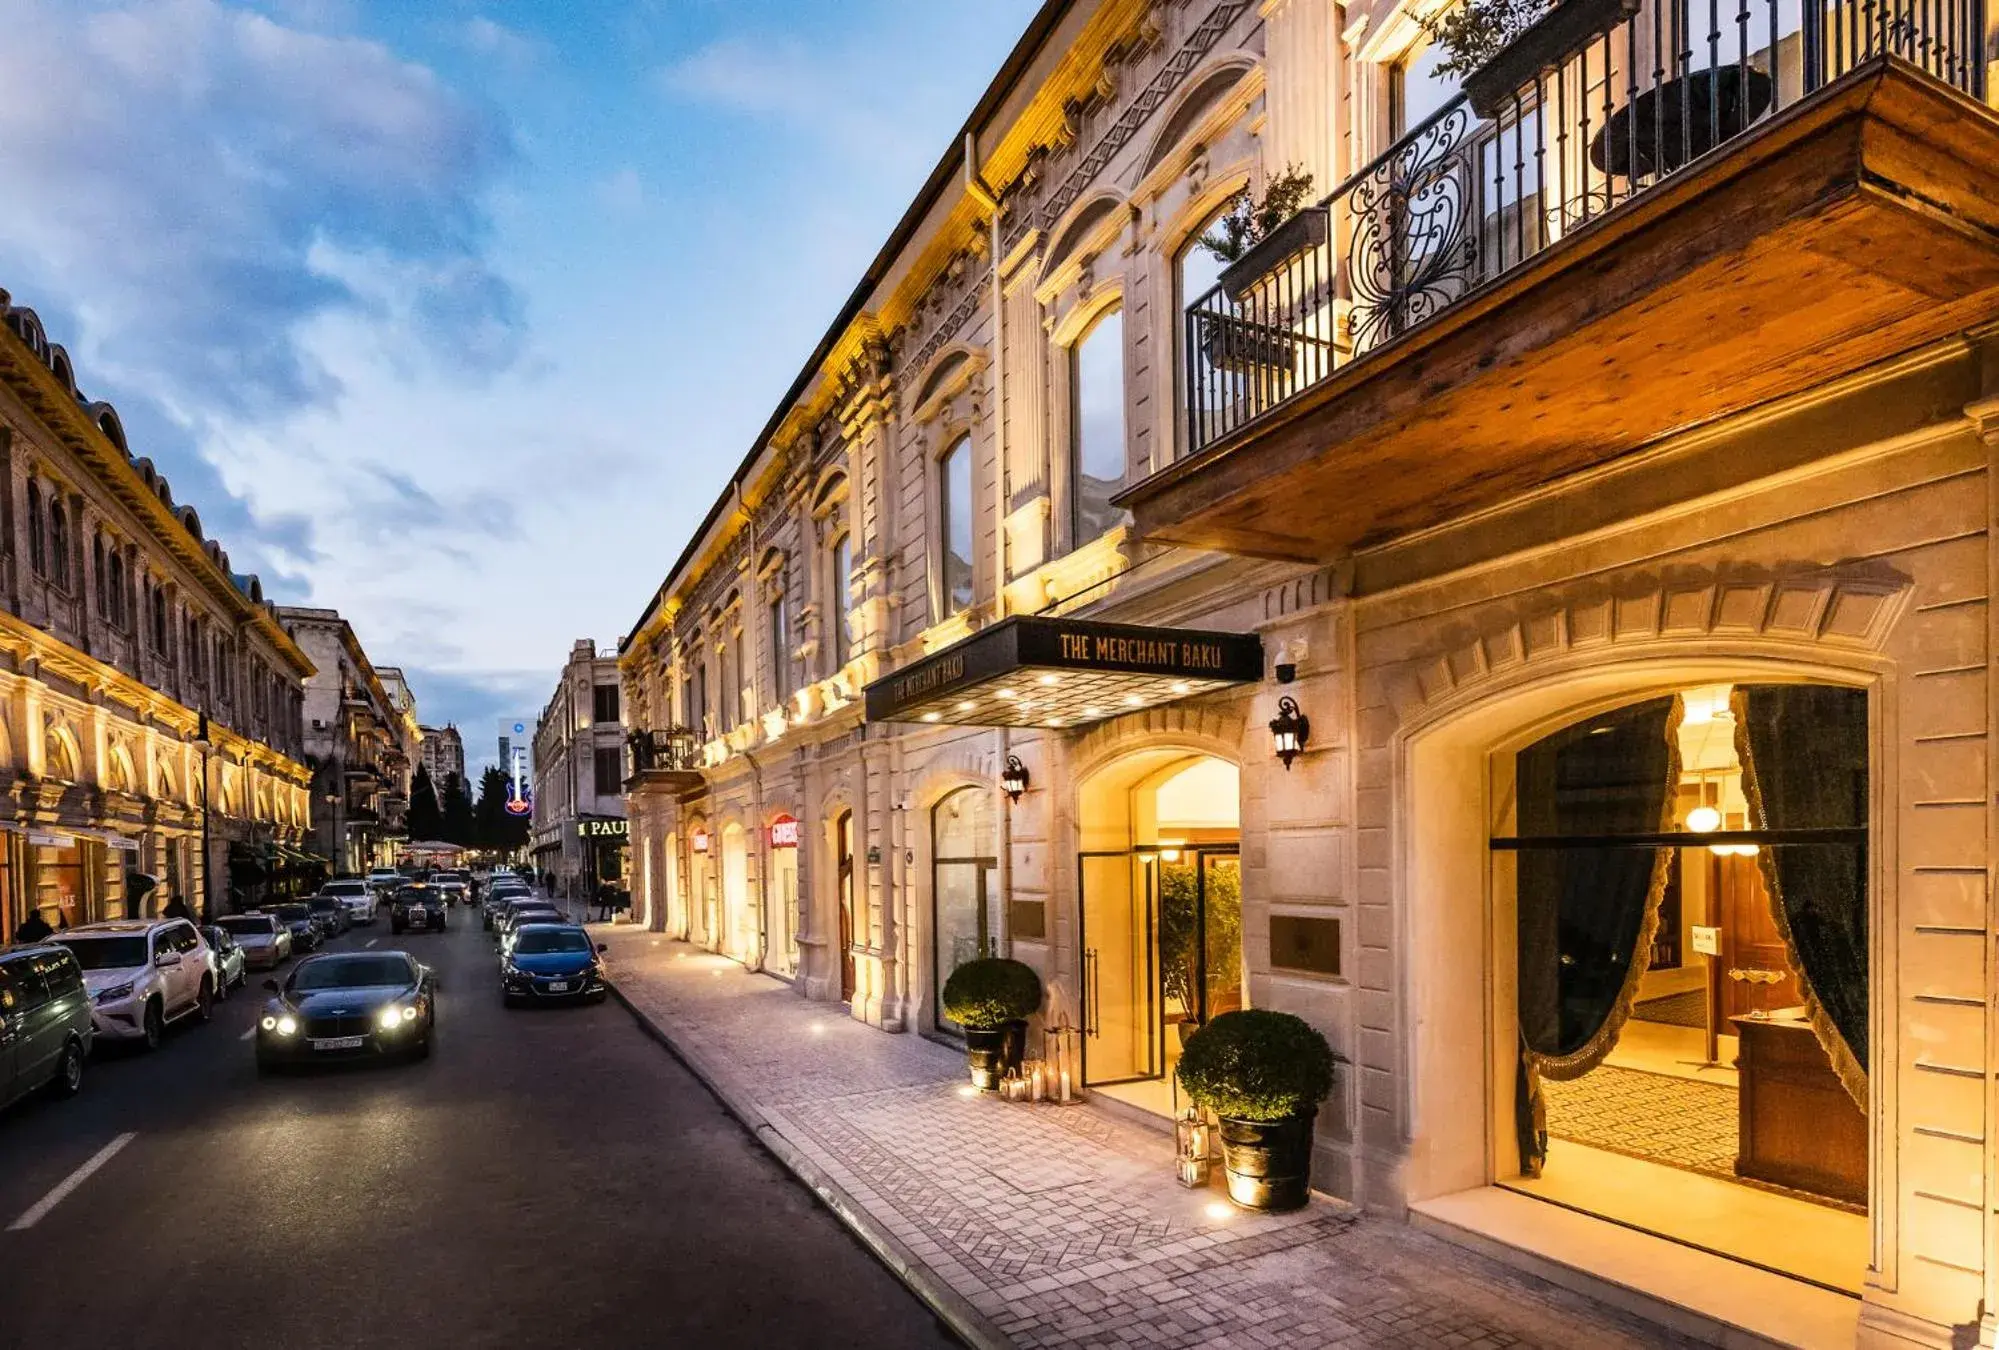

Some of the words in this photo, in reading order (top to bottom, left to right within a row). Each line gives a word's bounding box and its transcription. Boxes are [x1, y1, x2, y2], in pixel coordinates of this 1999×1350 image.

[1060, 634, 1090, 660] THE
[1096, 637, 1177, 665] MERCHANT
[1183, 643, 1221, 668] BAKU
